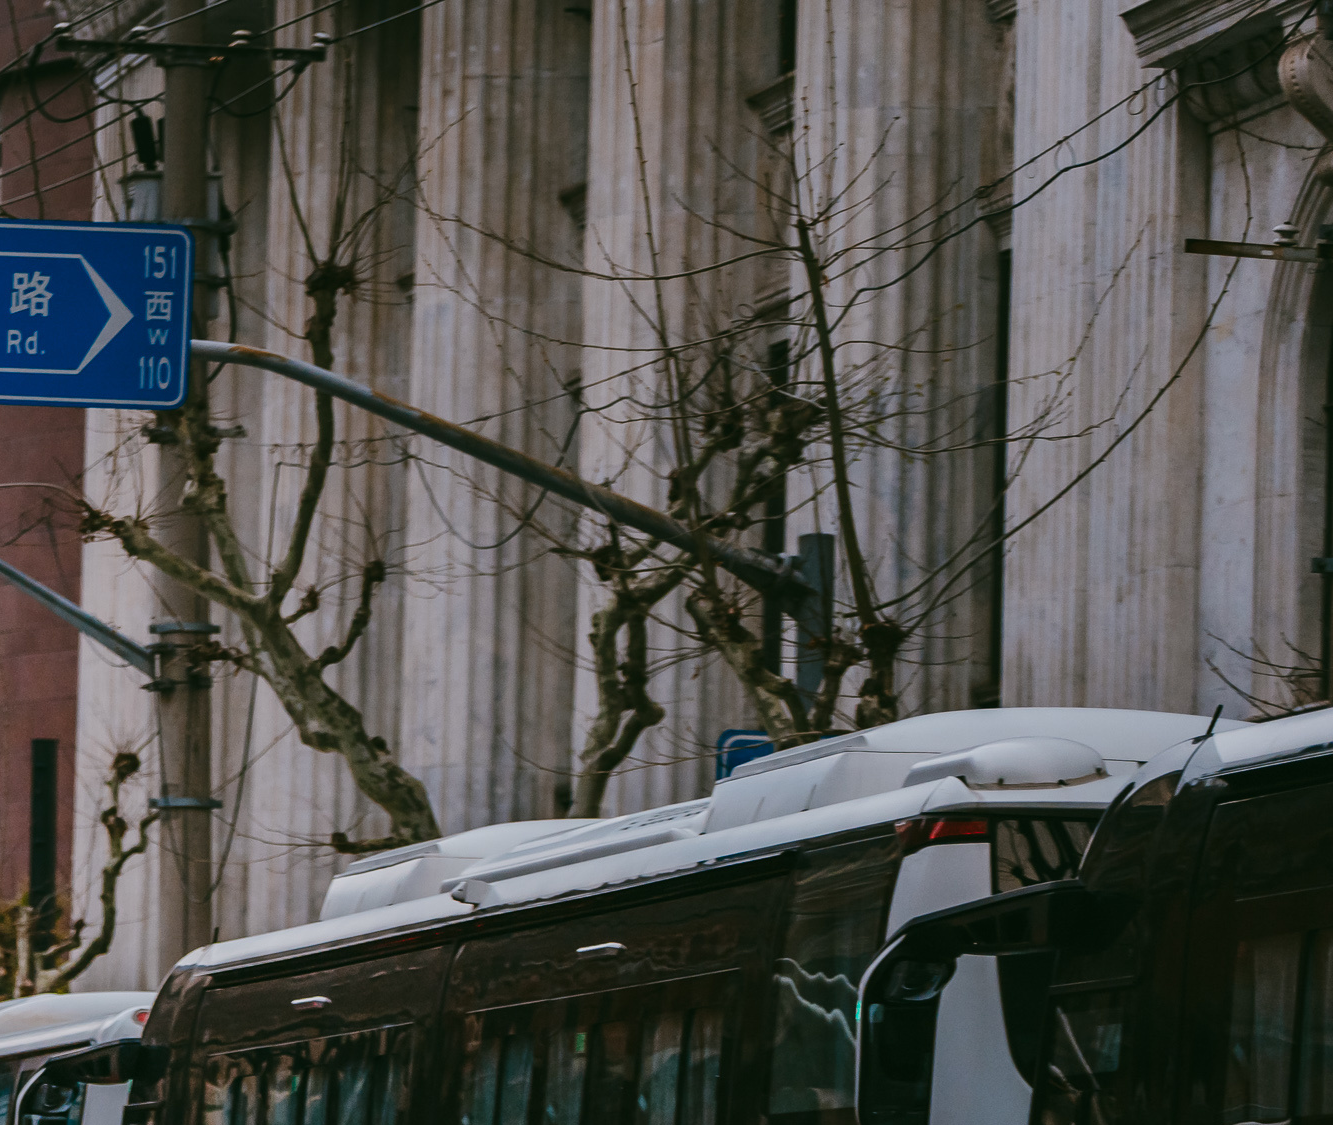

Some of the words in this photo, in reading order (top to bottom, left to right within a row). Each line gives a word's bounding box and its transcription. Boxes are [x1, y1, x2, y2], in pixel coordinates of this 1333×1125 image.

[143, 245, 178, 279] 151
[144, 290, 175, 322] 西
[6, 328, 46, 356] Rd.
[148, 328, 170, 346] W
[138, 356, 172, 390] 110
